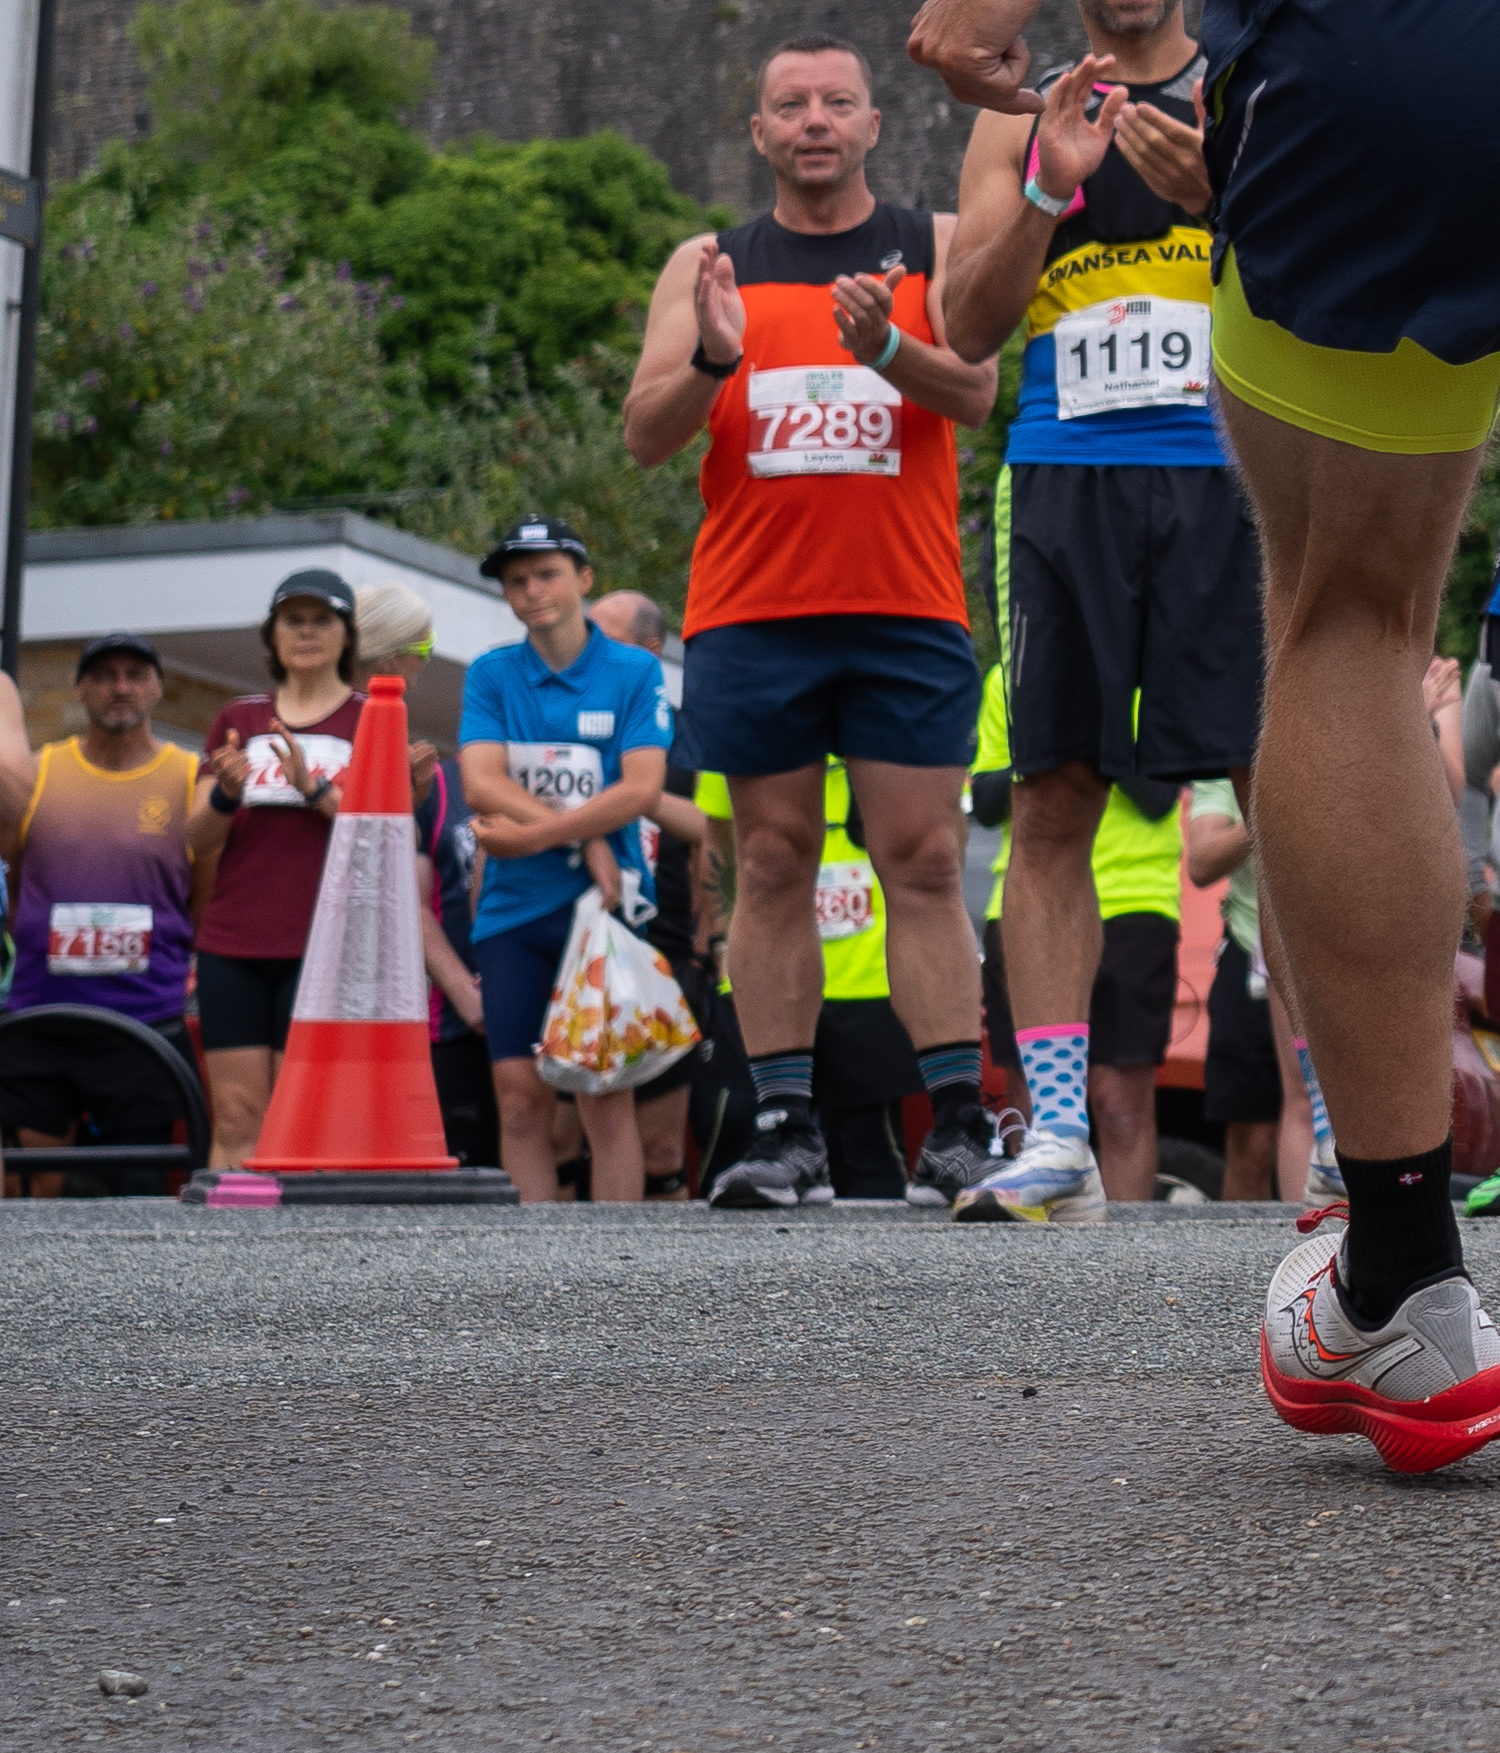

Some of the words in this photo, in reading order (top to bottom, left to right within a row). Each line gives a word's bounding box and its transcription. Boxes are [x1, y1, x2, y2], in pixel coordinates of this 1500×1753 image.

[1048, 247, 1152, 288] SWANSEA
[1157, 244, 1213, 262] VAL
[1070, 331, 1192, 379] 1119
[1104, 378, 1160, 393] Nathaniel
[757, 404, 893, 452] 7289
[803, 452, 844, 465] Leyton
[518, 768, 594, 798] 1206
